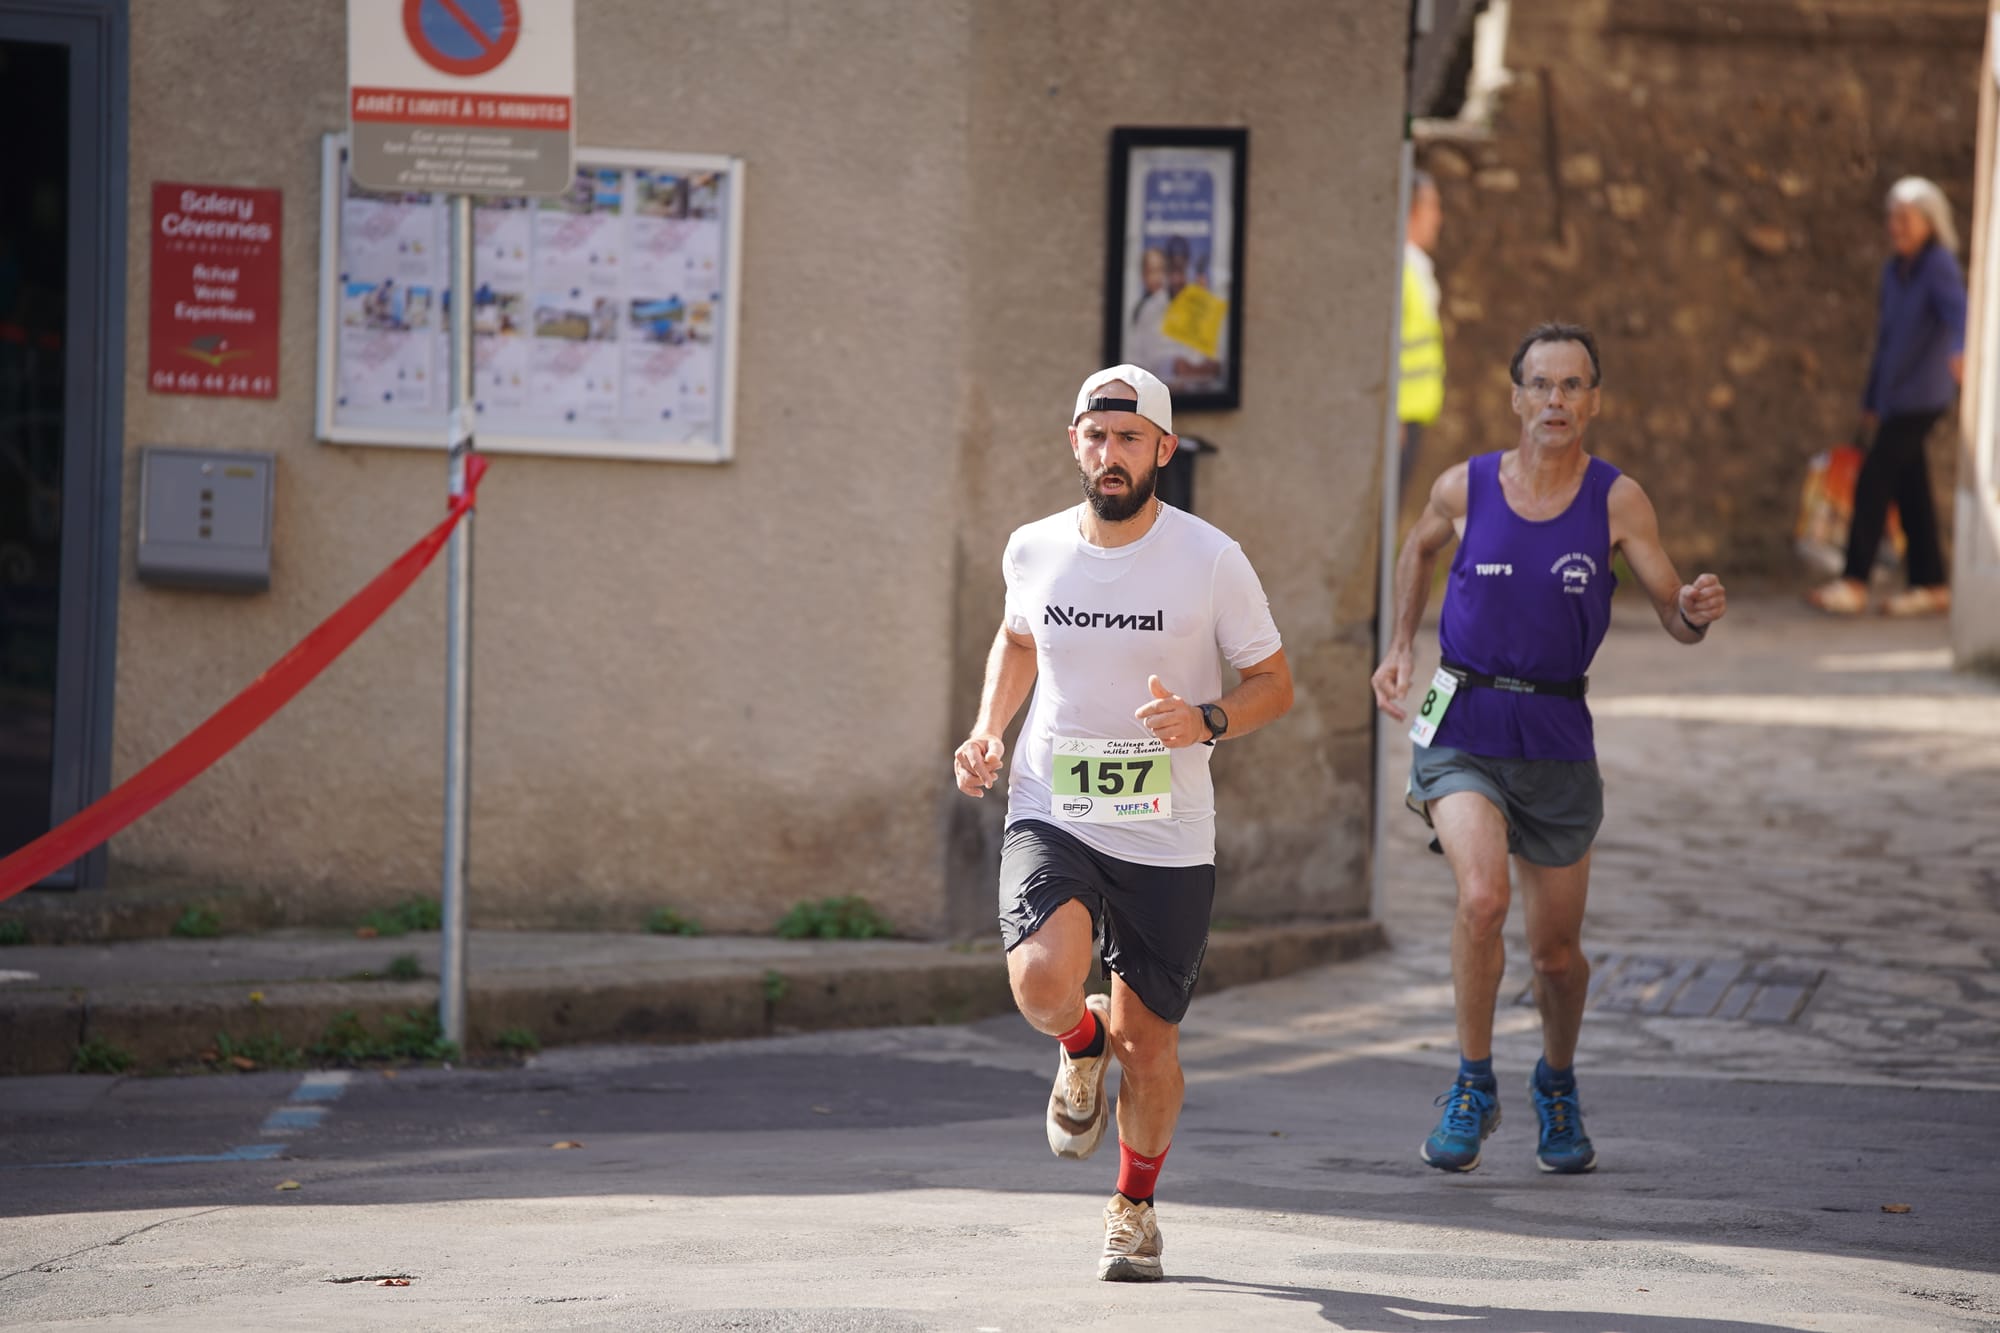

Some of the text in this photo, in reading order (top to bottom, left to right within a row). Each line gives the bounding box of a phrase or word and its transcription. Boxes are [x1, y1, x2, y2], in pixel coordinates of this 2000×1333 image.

[356, 95, 405, 114] ARRÊT
[408, 97, 459, 117] LIMITÉ
[478, 101, 496, 118] 15
[498, 103, 567, 121] MINUTES
[161, 212, 271, 242] Cévennes
[153, 370, 175, 388] 04
[1475, 563, 1513, 576] TUFF'S
[1107, 741, 1144, 750] Challenge
[1071, 760, 1153, 795] 157
[1063, 802, 1149, 812] BFP TUFF'S
